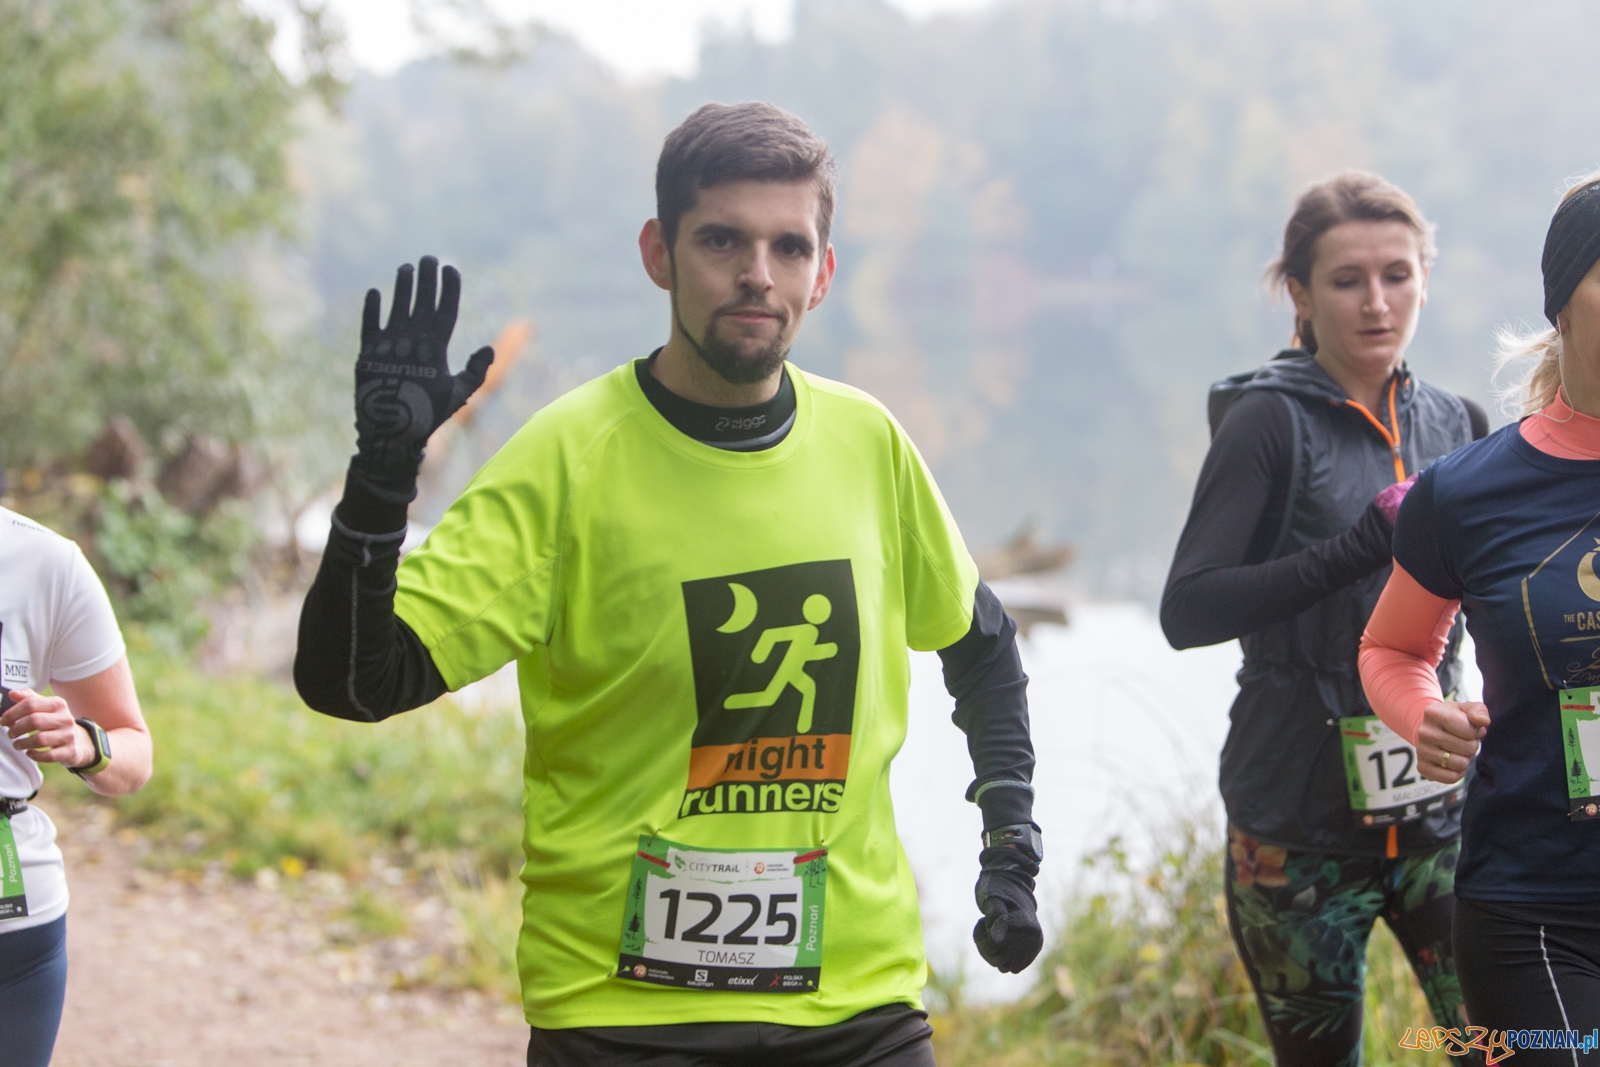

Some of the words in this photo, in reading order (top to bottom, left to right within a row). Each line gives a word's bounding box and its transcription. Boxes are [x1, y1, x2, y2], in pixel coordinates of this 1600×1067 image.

[1563, 614, 1576, 624] THE
[5, 663, 28, 678] MNIE
[725, 737, 826, 779] night
[1368, 746, 1427, 790] 12
[680, 781, 844, 818] runners
[4, 843, 18, 883] Poznań
[658, 888, 798, 945] 1225
[805, 903, 820, 952] Poznań
[698, 949, 756, 966] TOMASZ
[686, 980, 714, 988] salomon
